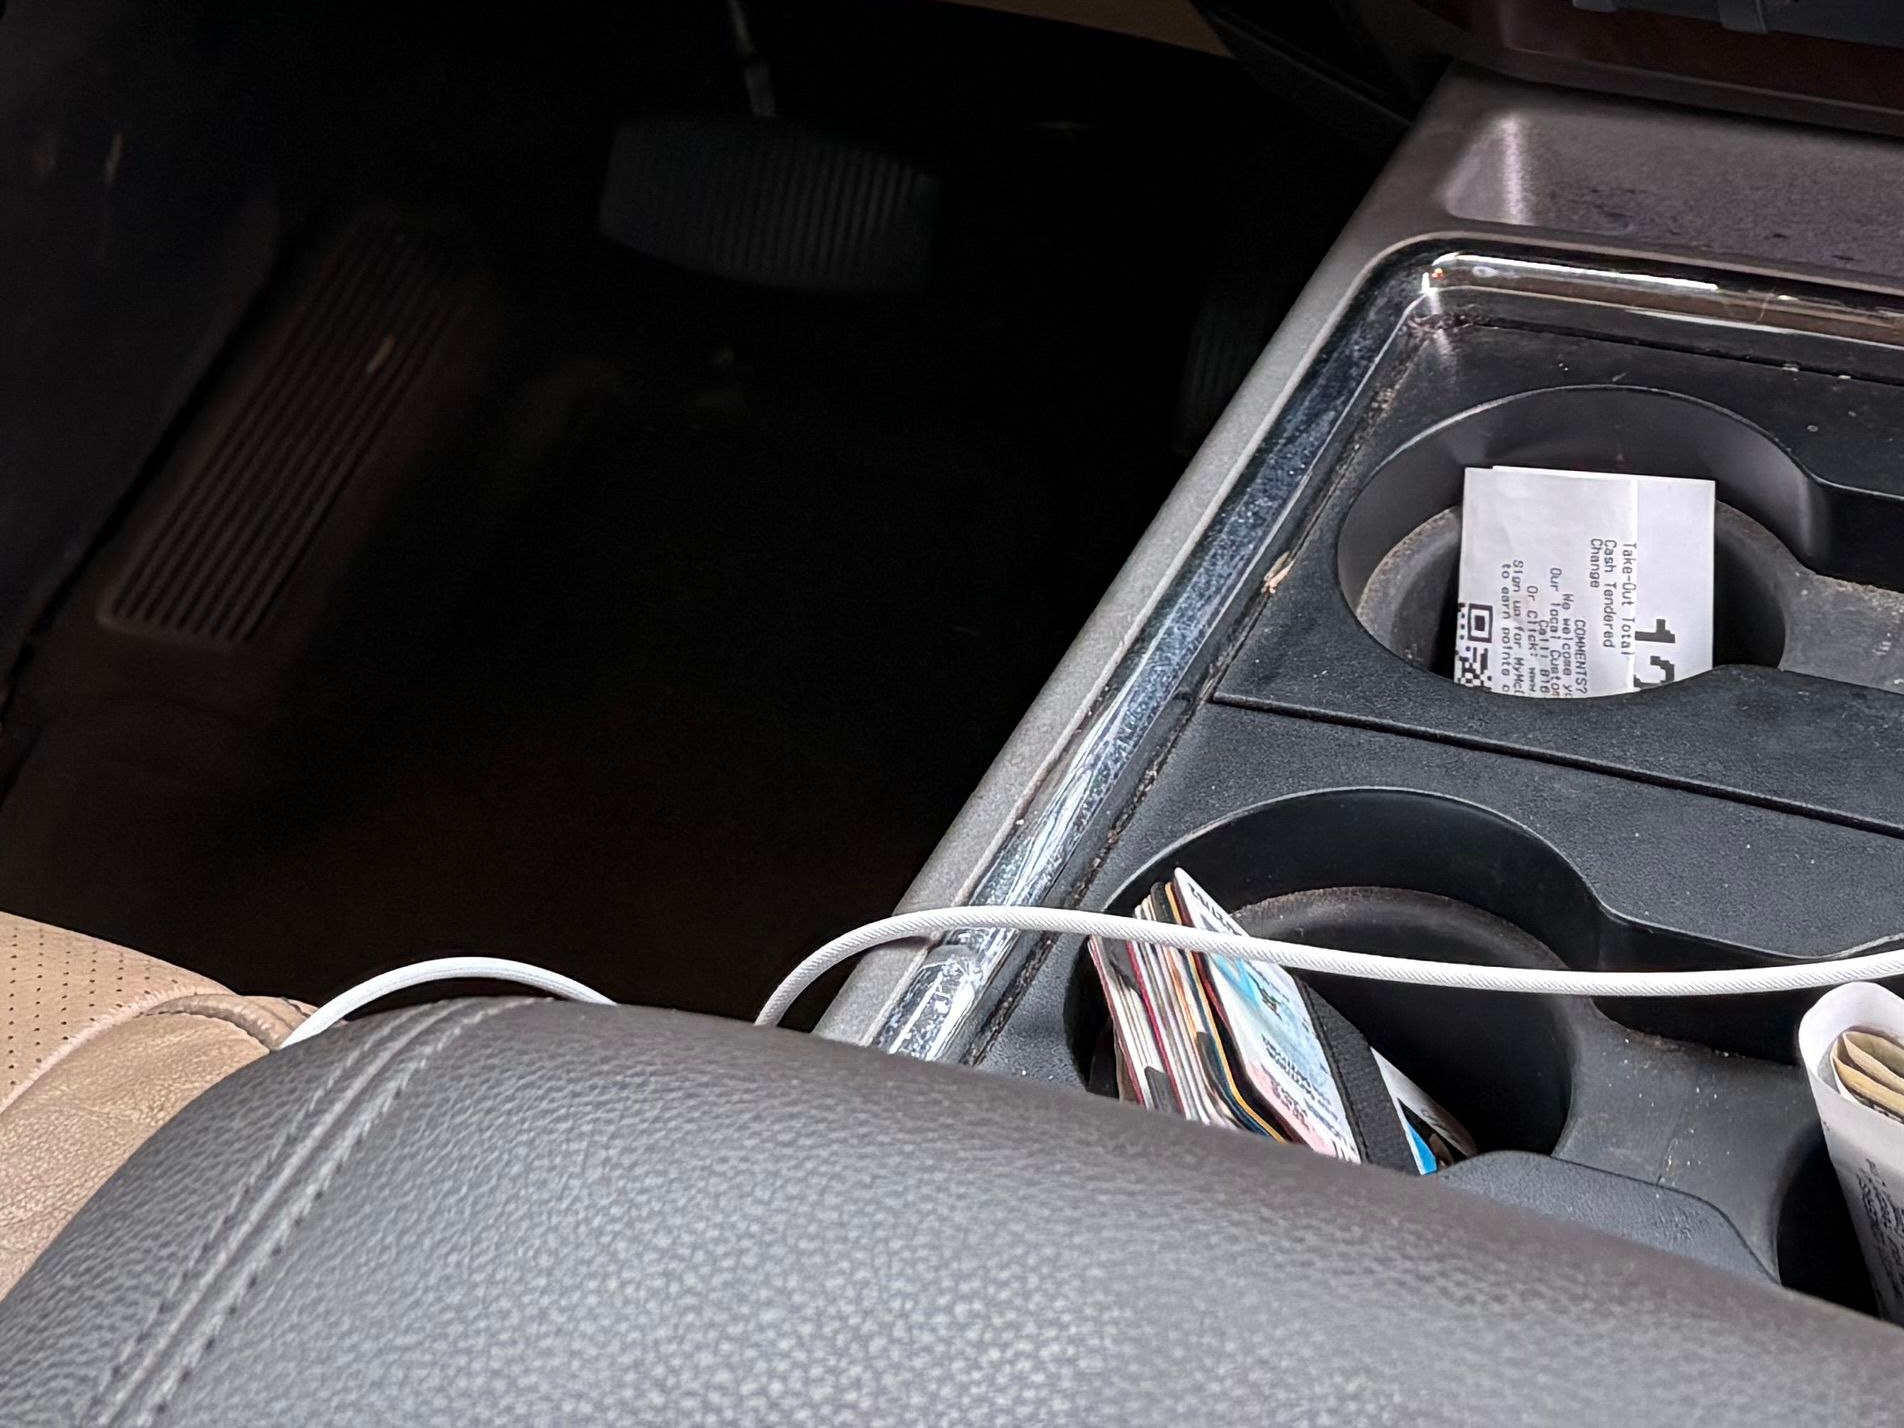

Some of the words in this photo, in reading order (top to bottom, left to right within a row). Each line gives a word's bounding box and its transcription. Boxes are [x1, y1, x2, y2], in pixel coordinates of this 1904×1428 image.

[1502, 564, 1511, 579] to
[1589, 539, 1603, 588] Change
[1604, 540, 1617, 572] Cash
[1512, 560, 1523, 592] Sign
[1550, 568, 1562, 591] Our
[1621, 543, 1637, 606] Take-Out
[1501, 587, 1511, 619] earn
[1527, 586, 1538, 601] Or
[1548, 603, 1562, 639] local
[1603, 582, 1616, 648] Tendered
[1501, 627, 1512, 676] points
[1514, 626, 1524, 648] for
[1527, 610, 1540, 657] Click:
[1561, 618, 1575, 676] welcome
[1621, 618, 1636, 655] Total
[1574, 620, 1588, 694] COMMENTS?
